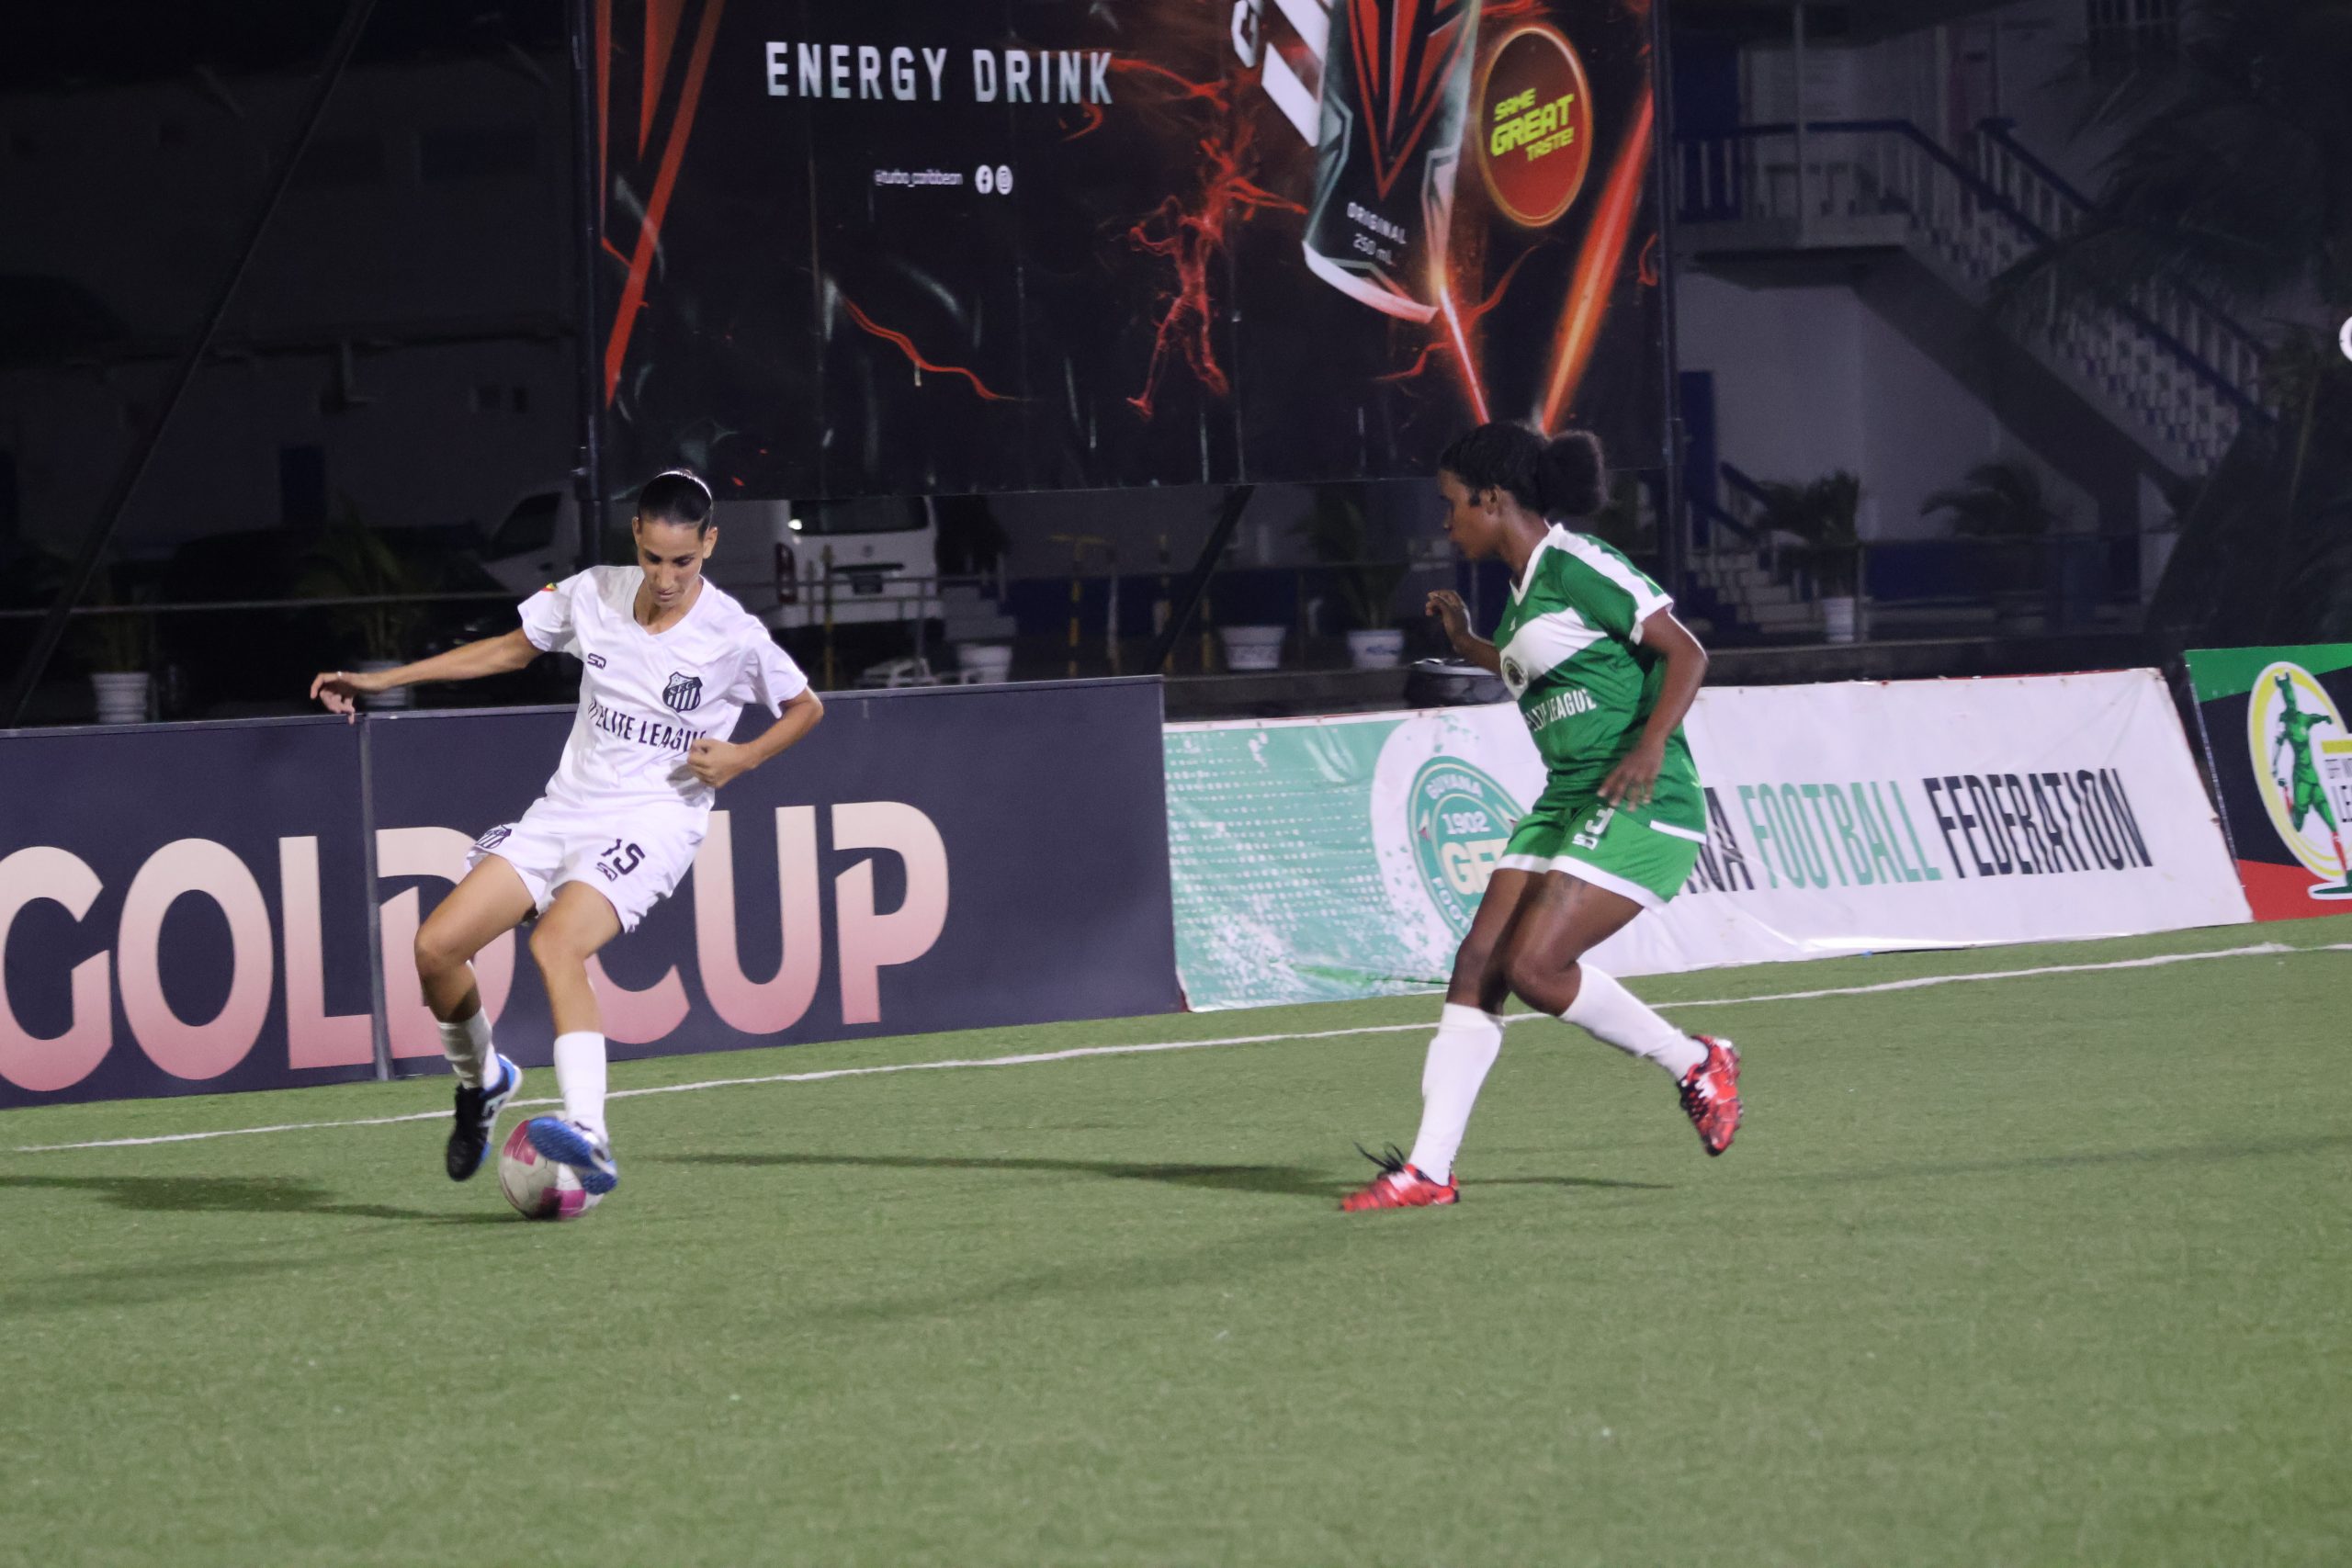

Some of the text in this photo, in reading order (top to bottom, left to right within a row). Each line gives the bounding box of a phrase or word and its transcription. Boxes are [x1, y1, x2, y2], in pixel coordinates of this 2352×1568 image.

[765, 41, 1112, 104] ENERGY DRINK
[1490, 93, 1575, 157] GREAT
[1493, 87, 1536, 122] SAME
[1347, 201, 1407, 244] ORIGINAL
[1352, 232, 1376, 255] 250
[1736, 781, 1943, 891] FOOTBALL
[1921, 767, 2154, 879] FEDERATION
[0, 827, 520, 1092] GOLD
